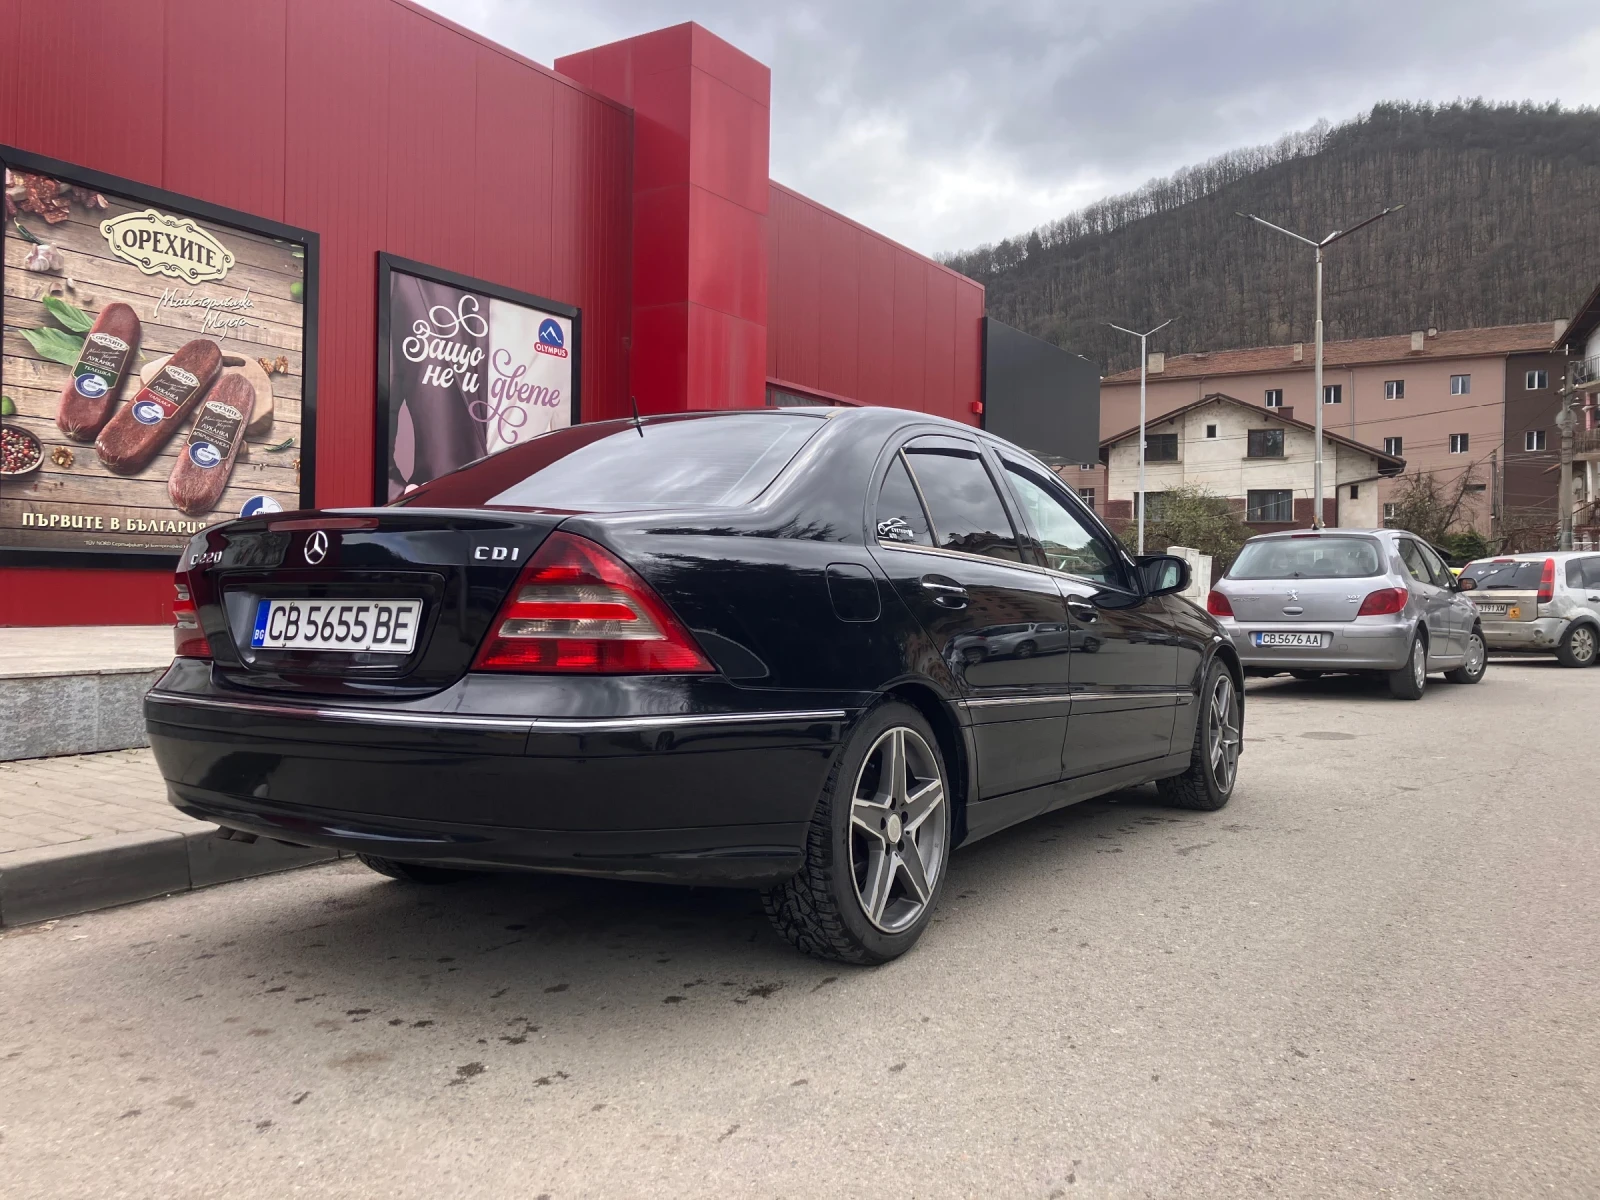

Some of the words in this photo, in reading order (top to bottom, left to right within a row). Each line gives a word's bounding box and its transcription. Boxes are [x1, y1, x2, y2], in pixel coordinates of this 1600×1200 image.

[122, 229, 217, 269] ОРЕХИТЕ
[402, 304, 488, 373] Защо
[535, 343, 566, 357] OLYMPUS
[87, 355, 116, 368] ЛУКАНКА
[84, 365, 112, 377] ТЕЛЕШКА
[422, 364, 454, 388] не
[462, 372, 479, 393] и
[153, 385, 179, 401] ЛУКАНКА
[201, 423, 229, 439] ЛУКАНКА
[22, 512, 104, 529] ПЪРВИТЕ
[110, 517, 120, 530] В
[199, 551, 223, 564] 220
[474, 546, 520, 561] CDI
[254, 629, 265, 640] BG
